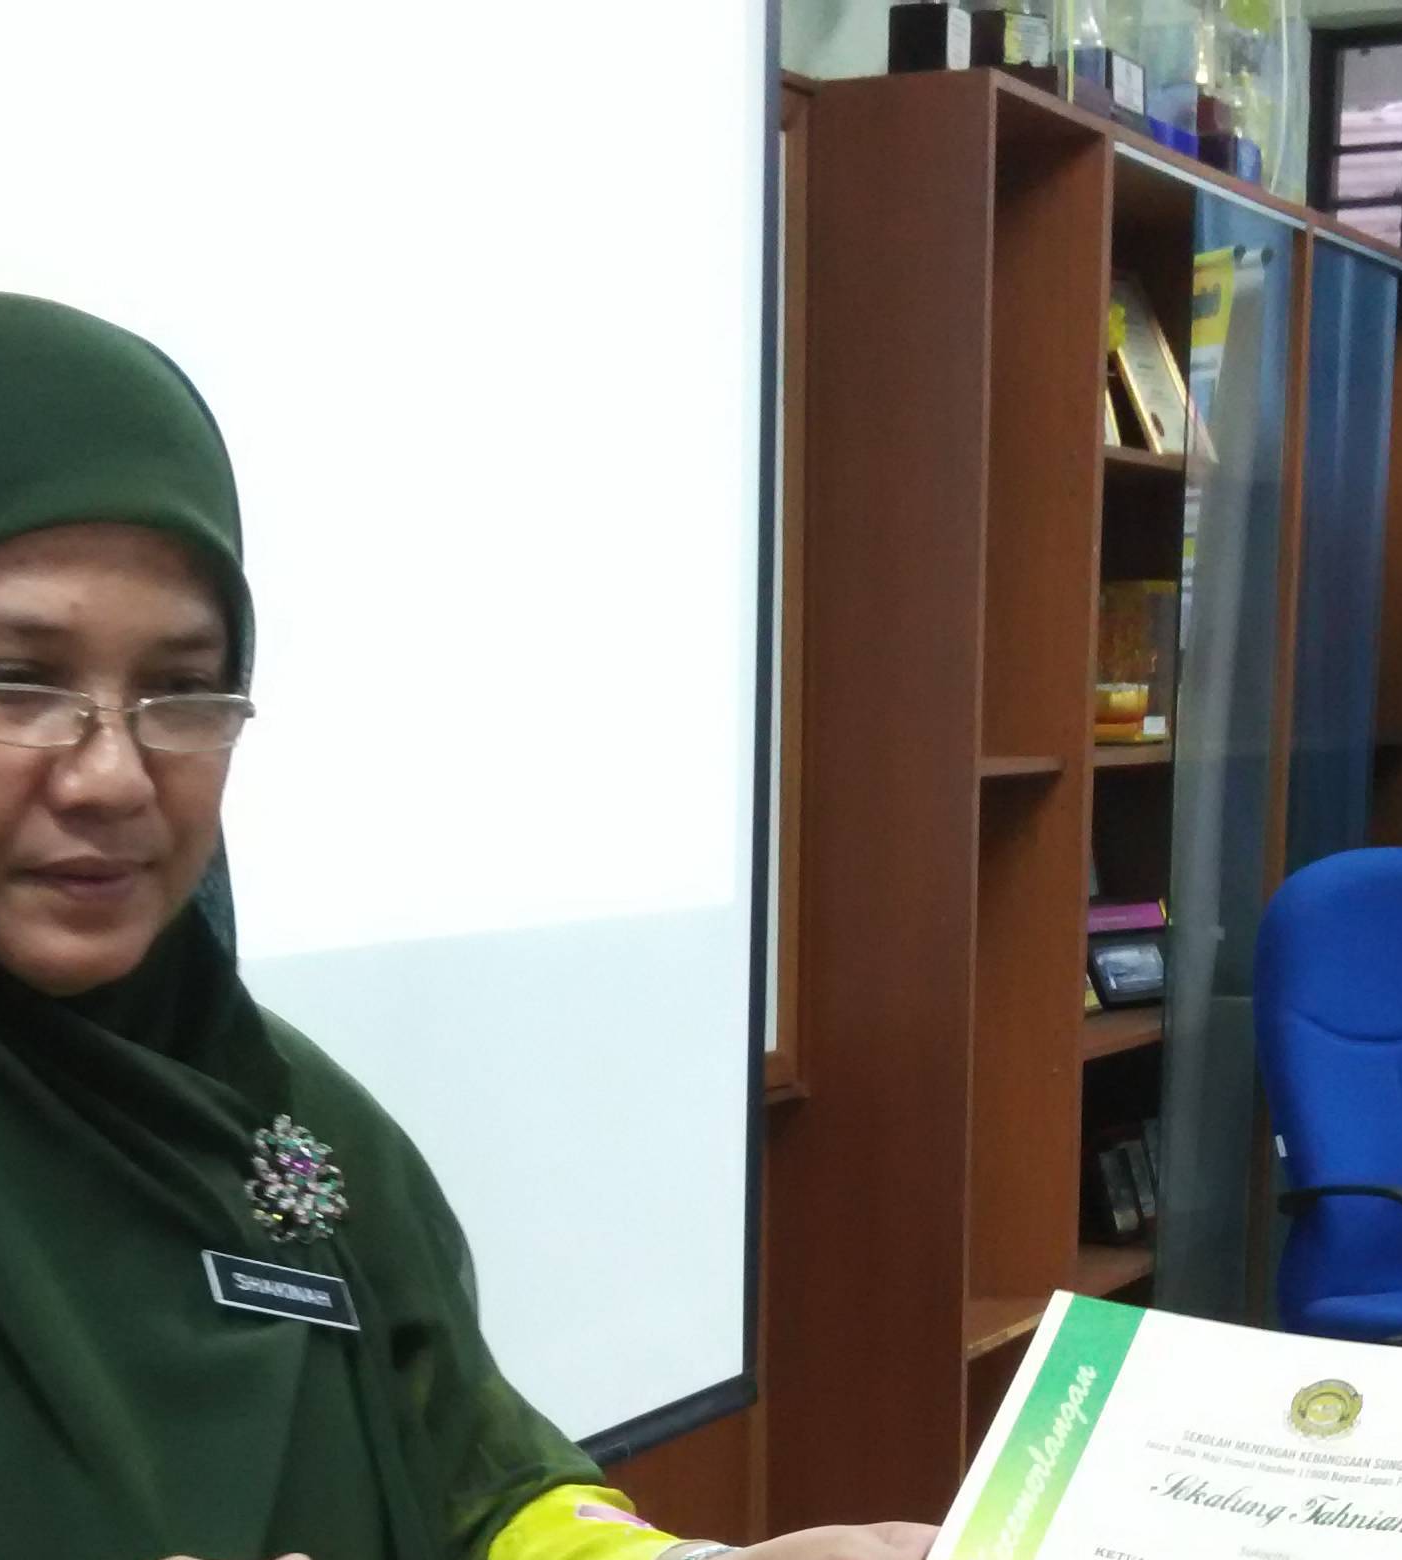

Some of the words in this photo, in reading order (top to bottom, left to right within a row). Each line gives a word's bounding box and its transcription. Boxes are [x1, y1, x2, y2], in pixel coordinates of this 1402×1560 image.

[1182, 1429, 1233, 1449] SEKOLAH
[1234, 1440, 1297, 1461] MENENGAH
[1298, 1450, 1372, 1470] KEBANGSAAN
[1331, 1471, 1362, 1485] Bayan
[1149, 1471, 1287, 1528] Sekalung
